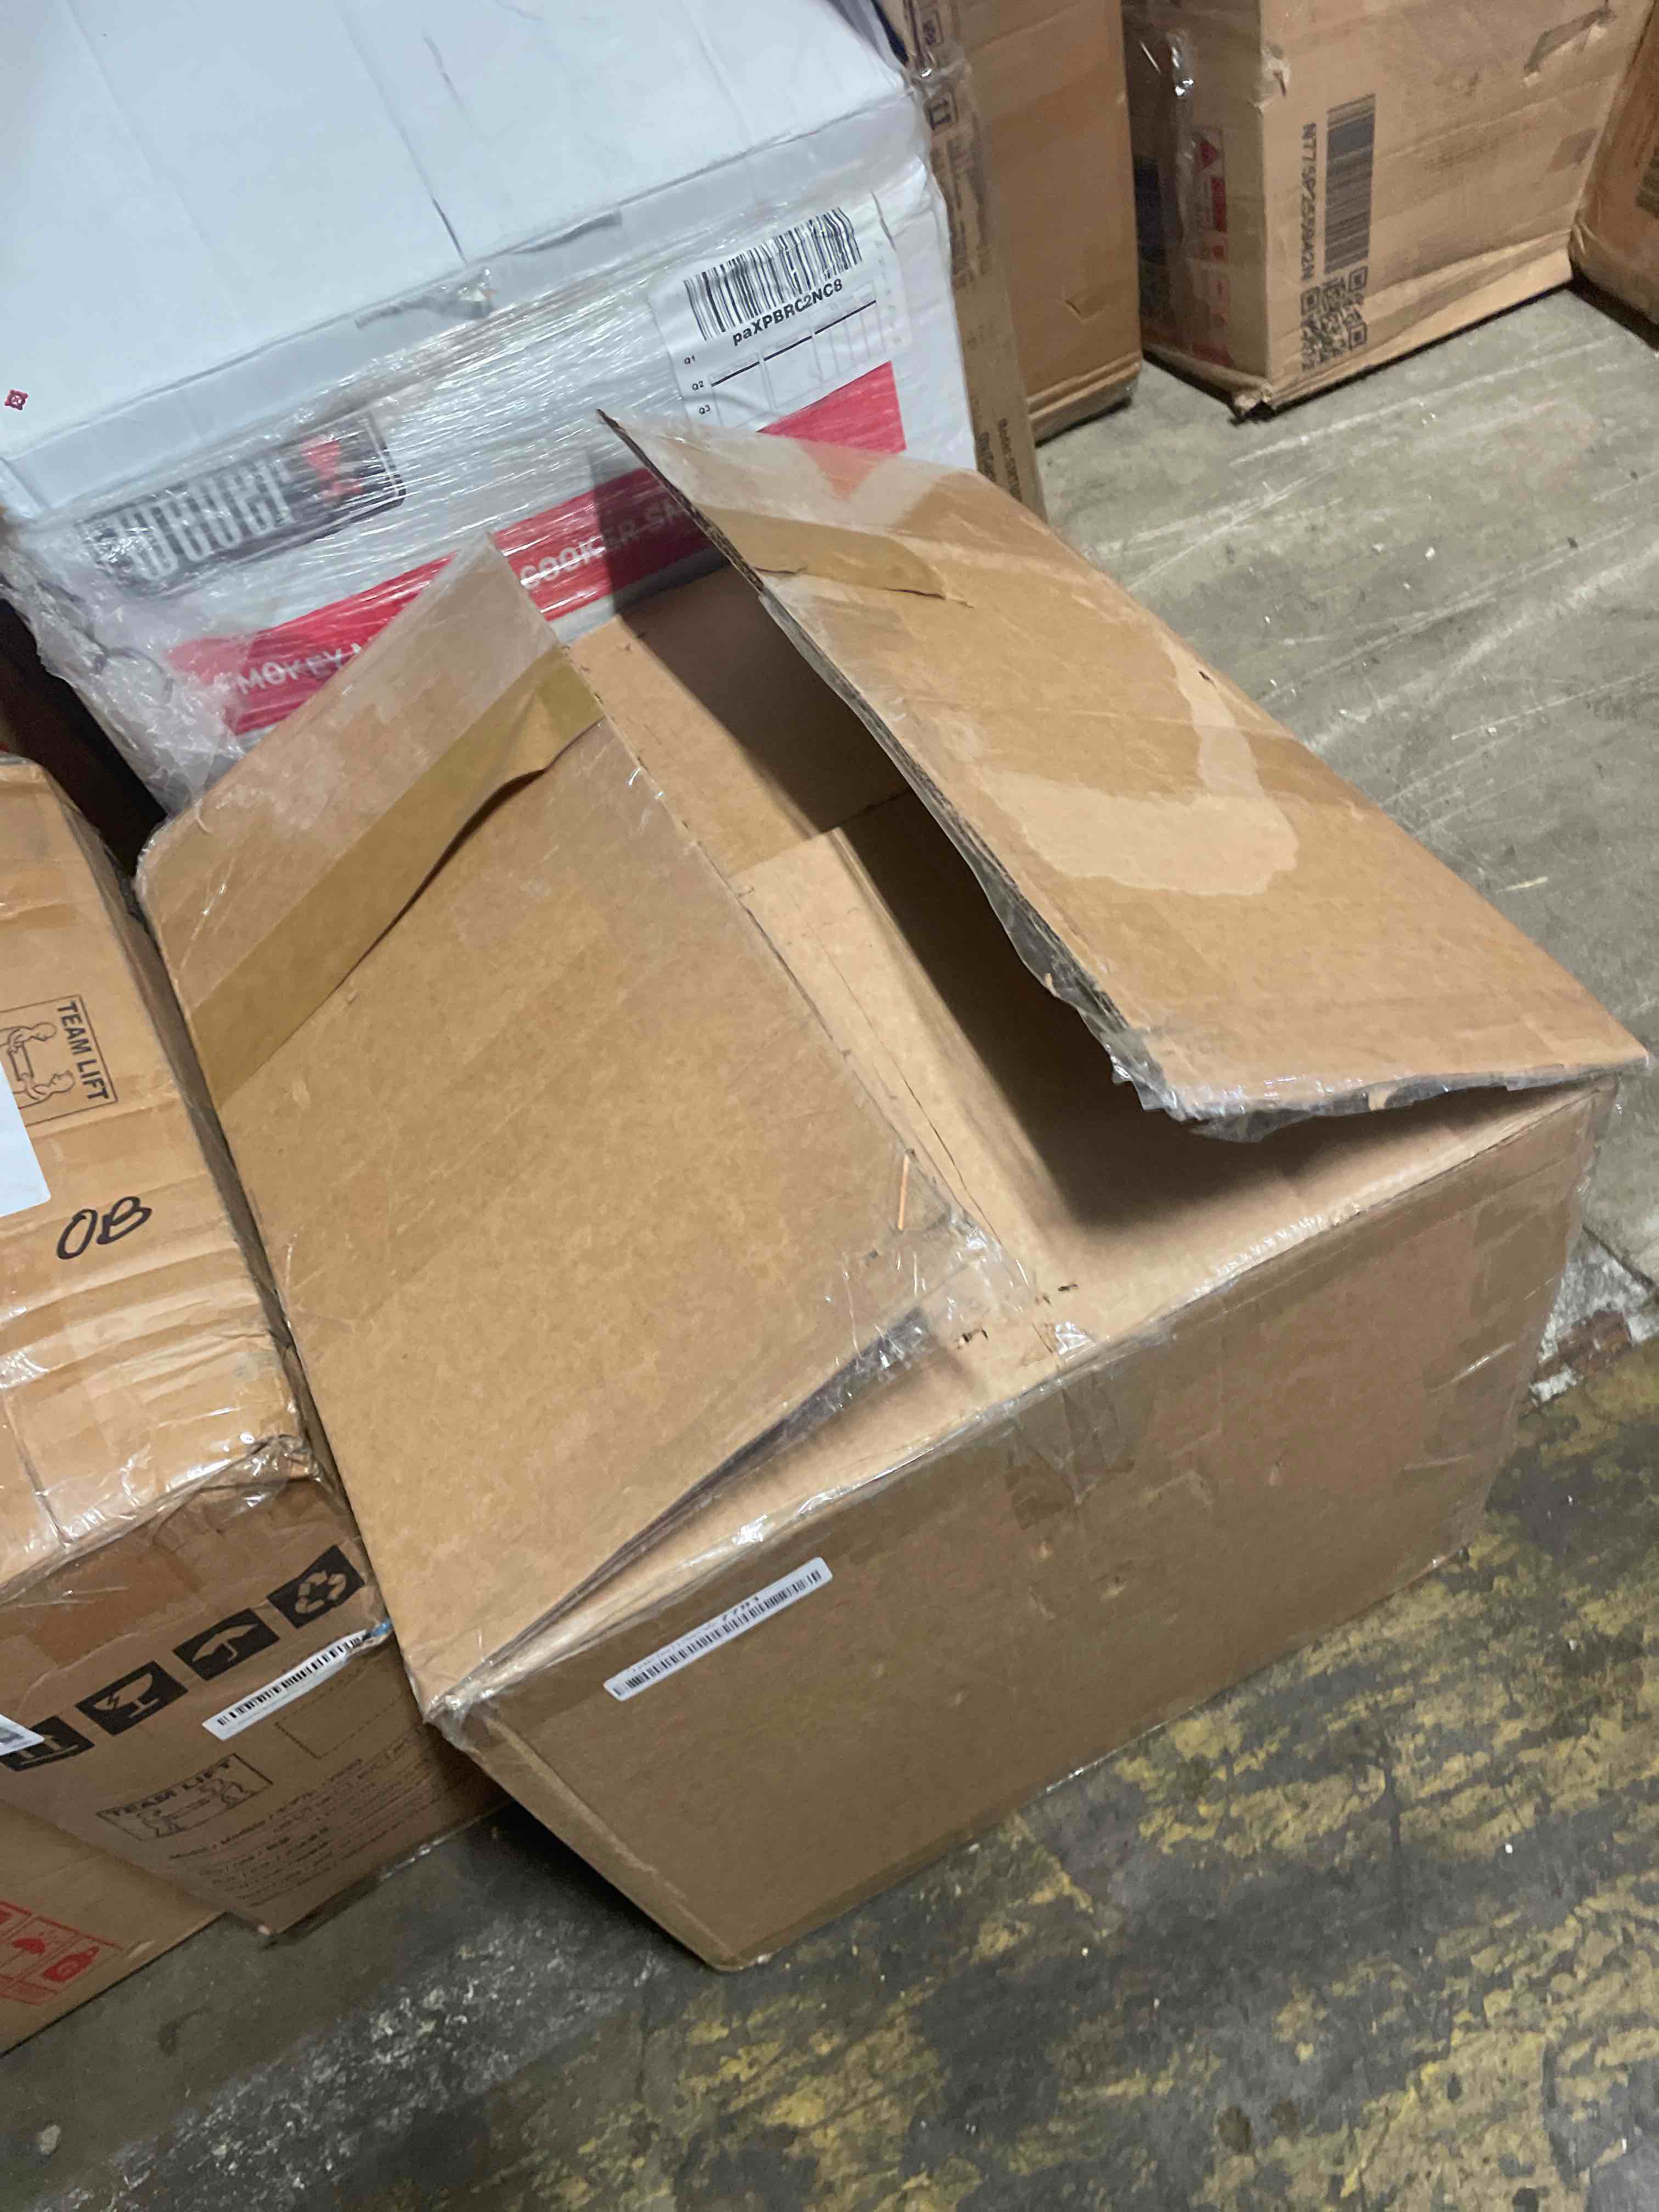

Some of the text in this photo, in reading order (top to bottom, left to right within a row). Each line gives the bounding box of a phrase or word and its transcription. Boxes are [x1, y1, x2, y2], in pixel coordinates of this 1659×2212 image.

[732, 279, 843, 346] paXPBRC2NC8
[684, 356, 697, 365] Q1
[692, 381, 705, 391] Q2
[698, 404, 712, 415] Q3
[57, 1000, 109, 1100] TEAM LIFT
